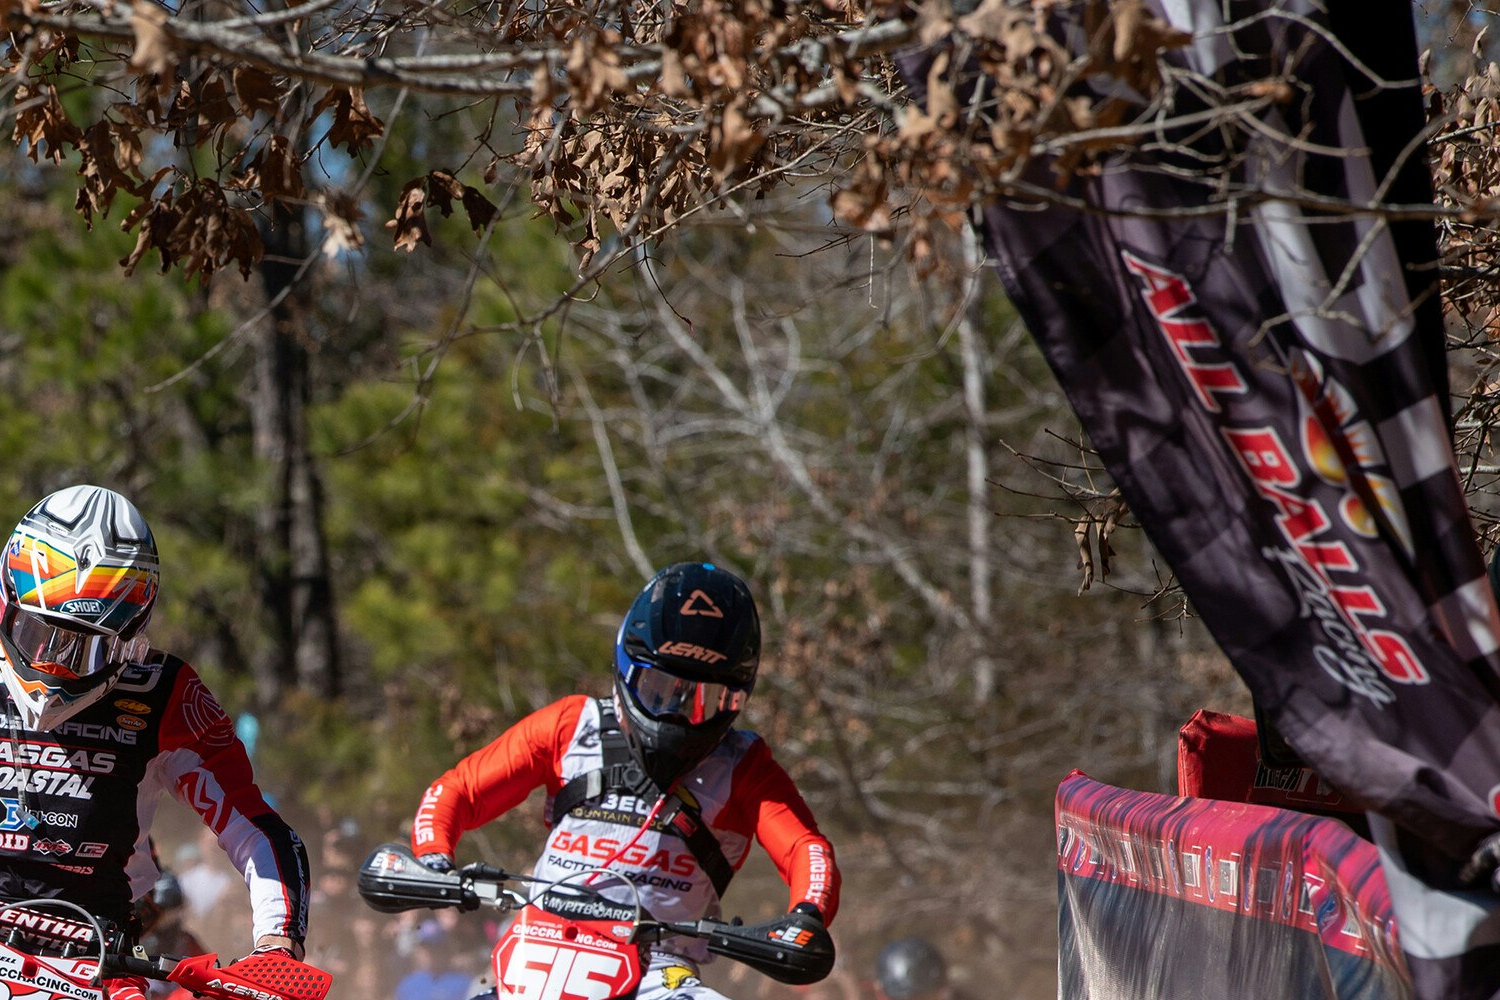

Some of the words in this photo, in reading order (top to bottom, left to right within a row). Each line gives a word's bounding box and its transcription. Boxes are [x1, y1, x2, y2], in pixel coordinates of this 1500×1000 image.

[1122, 249, 1248, 413] ALL
[1220, 426, 1430, 686] BALLS
[659, 641, 728, 664] LEATT
[573, 806, 632, 824] OUNTAIN
[551, 830, 697, 878] GASGAS
[622, 870, 693, 893] RACING
[512, 923, 618, 951] GNCCRANG.COM
